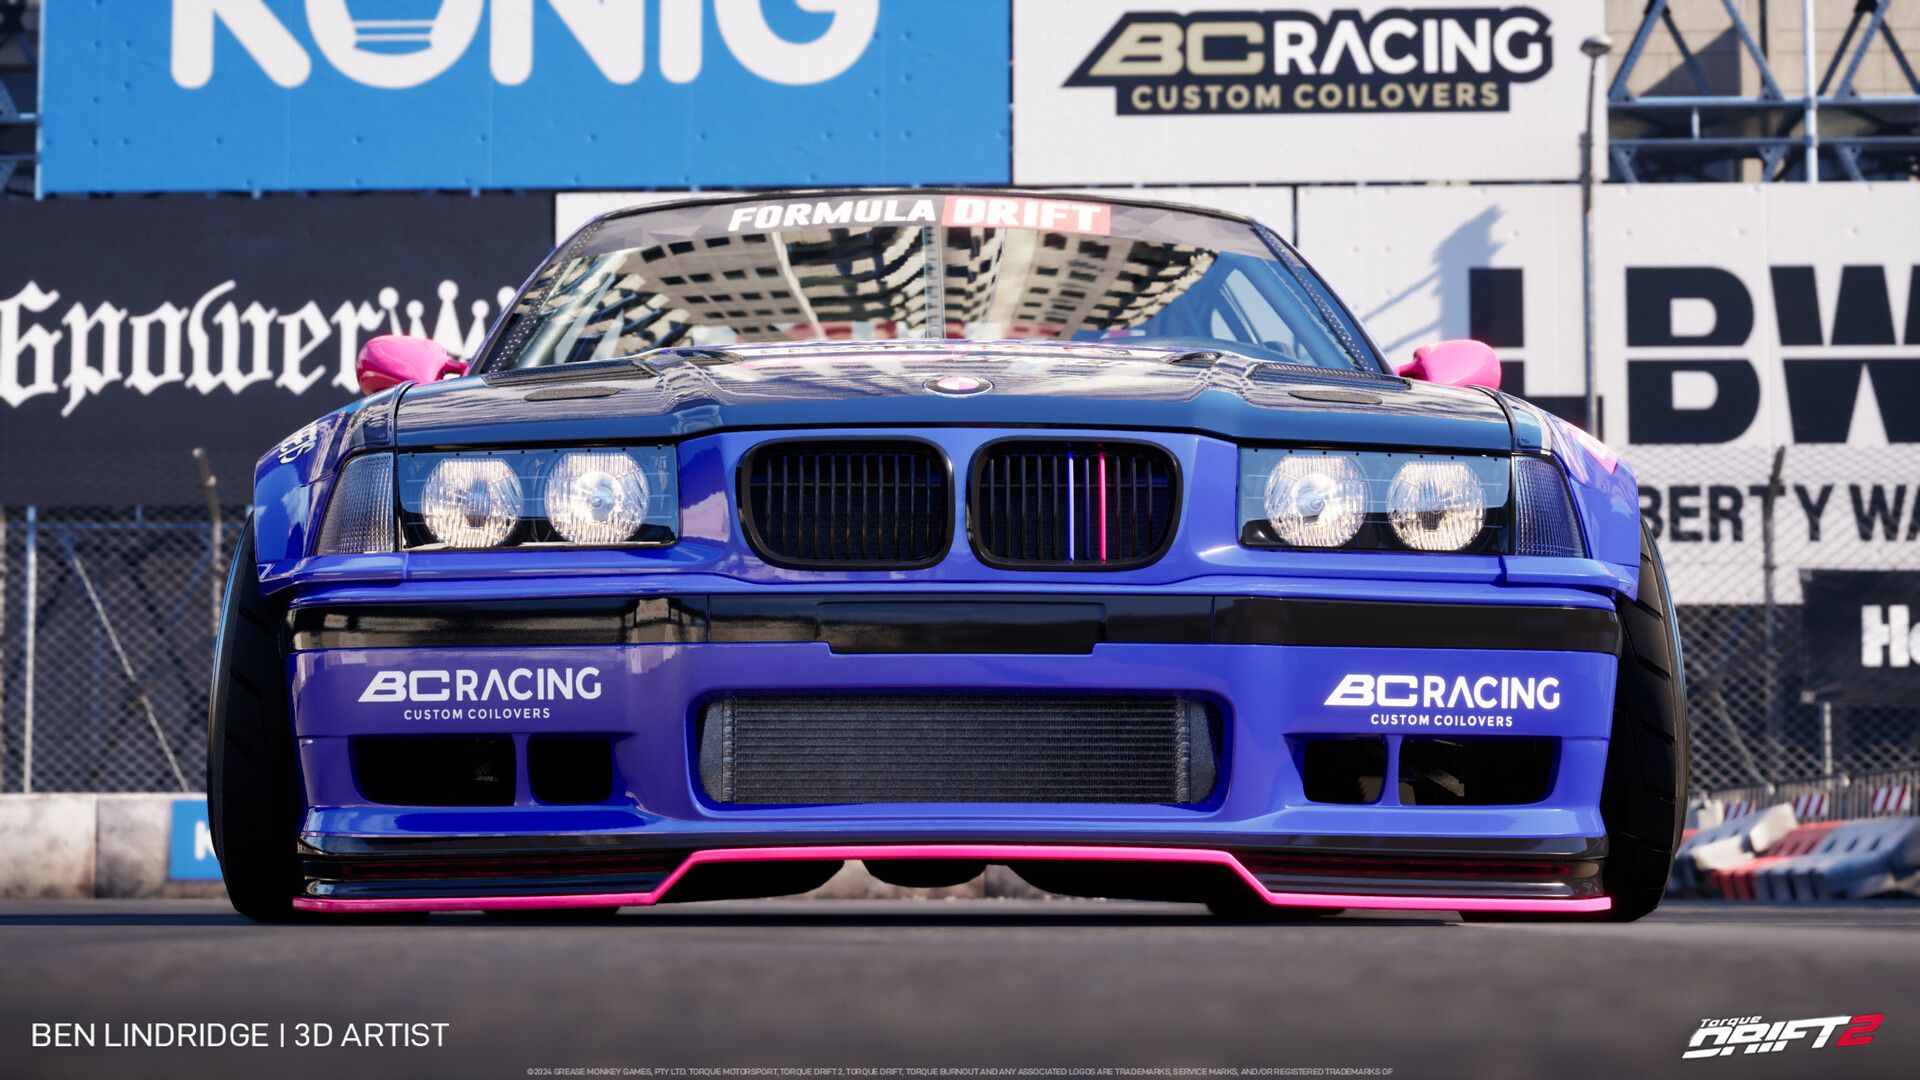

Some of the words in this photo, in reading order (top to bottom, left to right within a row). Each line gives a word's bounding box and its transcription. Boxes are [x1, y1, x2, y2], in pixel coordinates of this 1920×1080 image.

[1131, 84, 1282, 110] CUSTOM
[1293, 81, 1500, 109] COILOVERS
[727, 198, 938, 232] FORMULA
[951, 196, 1102, 232] DRIFT
[403, 708, 463, 721] CUSTOM
[467, 707, 551, 720] COILOVERS
[1370, 713, 1430, 726] CUSTOM
[1434, 714, 1514, 727] COILOVERS
